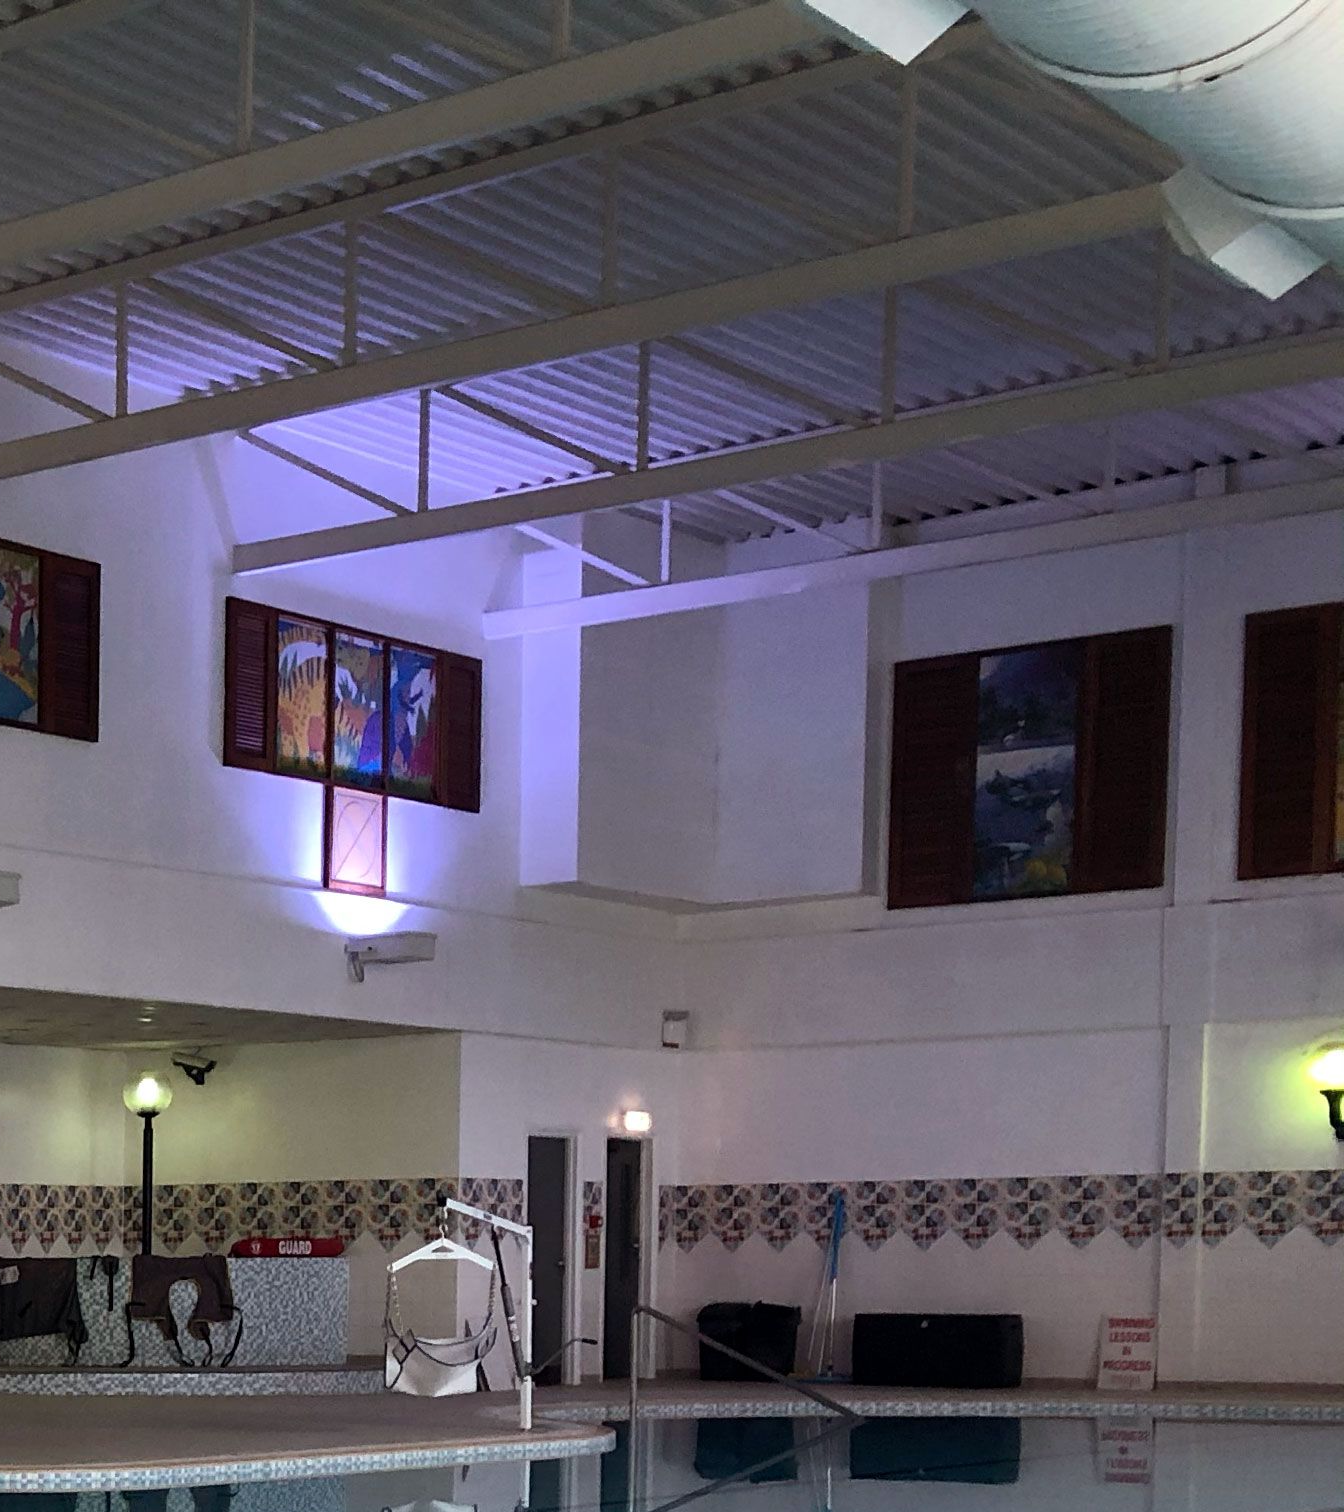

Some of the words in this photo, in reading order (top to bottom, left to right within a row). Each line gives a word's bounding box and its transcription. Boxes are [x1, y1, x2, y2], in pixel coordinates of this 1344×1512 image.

[278, 1240, 312, 1254] GUARD
[1108, 1331, 1152, 1343] LESSONS
[1103, 1359, 1152, 1371] PROGRESS
